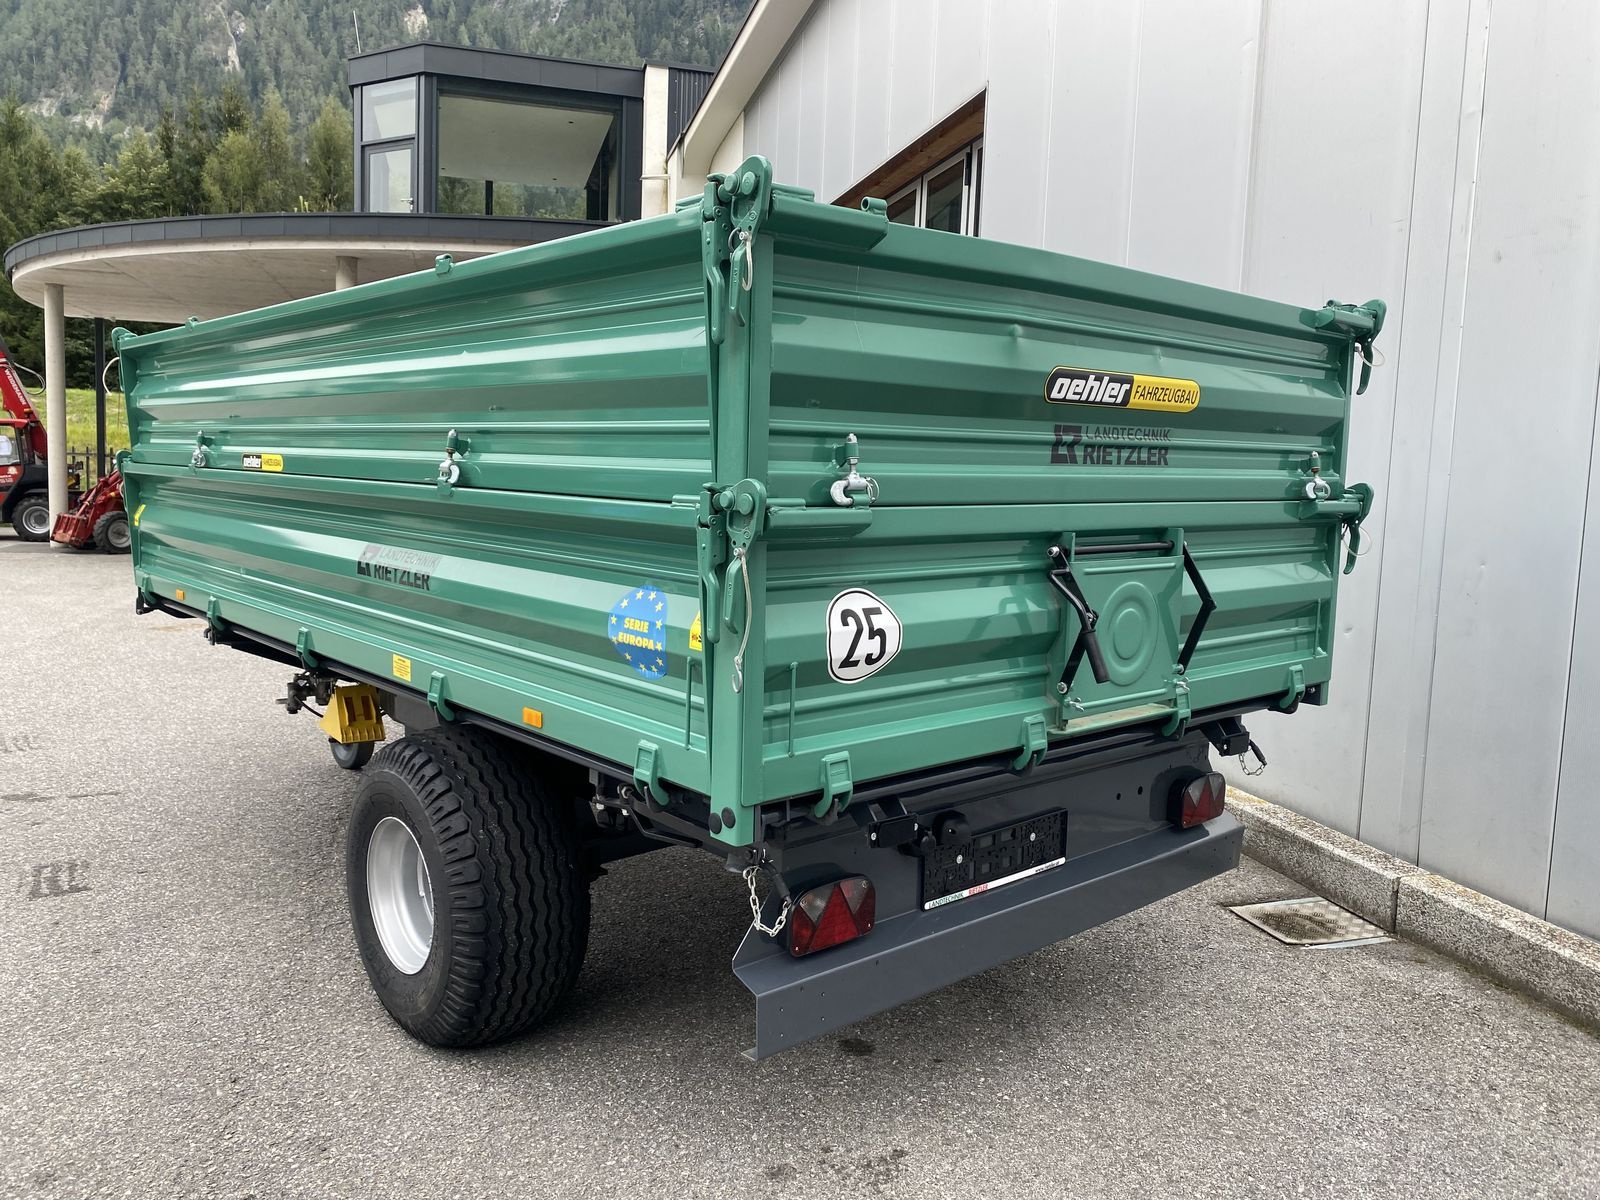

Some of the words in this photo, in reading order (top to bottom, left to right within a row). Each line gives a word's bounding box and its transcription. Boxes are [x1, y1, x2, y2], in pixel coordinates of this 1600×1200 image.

[1050, 374, 1131, 404] oehler
[1133, 385, 1199, 405] FAHRZEUGBAU
[1085, 425, 1172, 442] LANDTECHNIK
[1082, 445, 1169, 466] RIETZLER
[373, 561, 431, 591] RIETZLER
[623, 616, 650, 634] SERIE
[617, 631, 655, 651] EUROPA
[838, 606, 887, 670] 25
